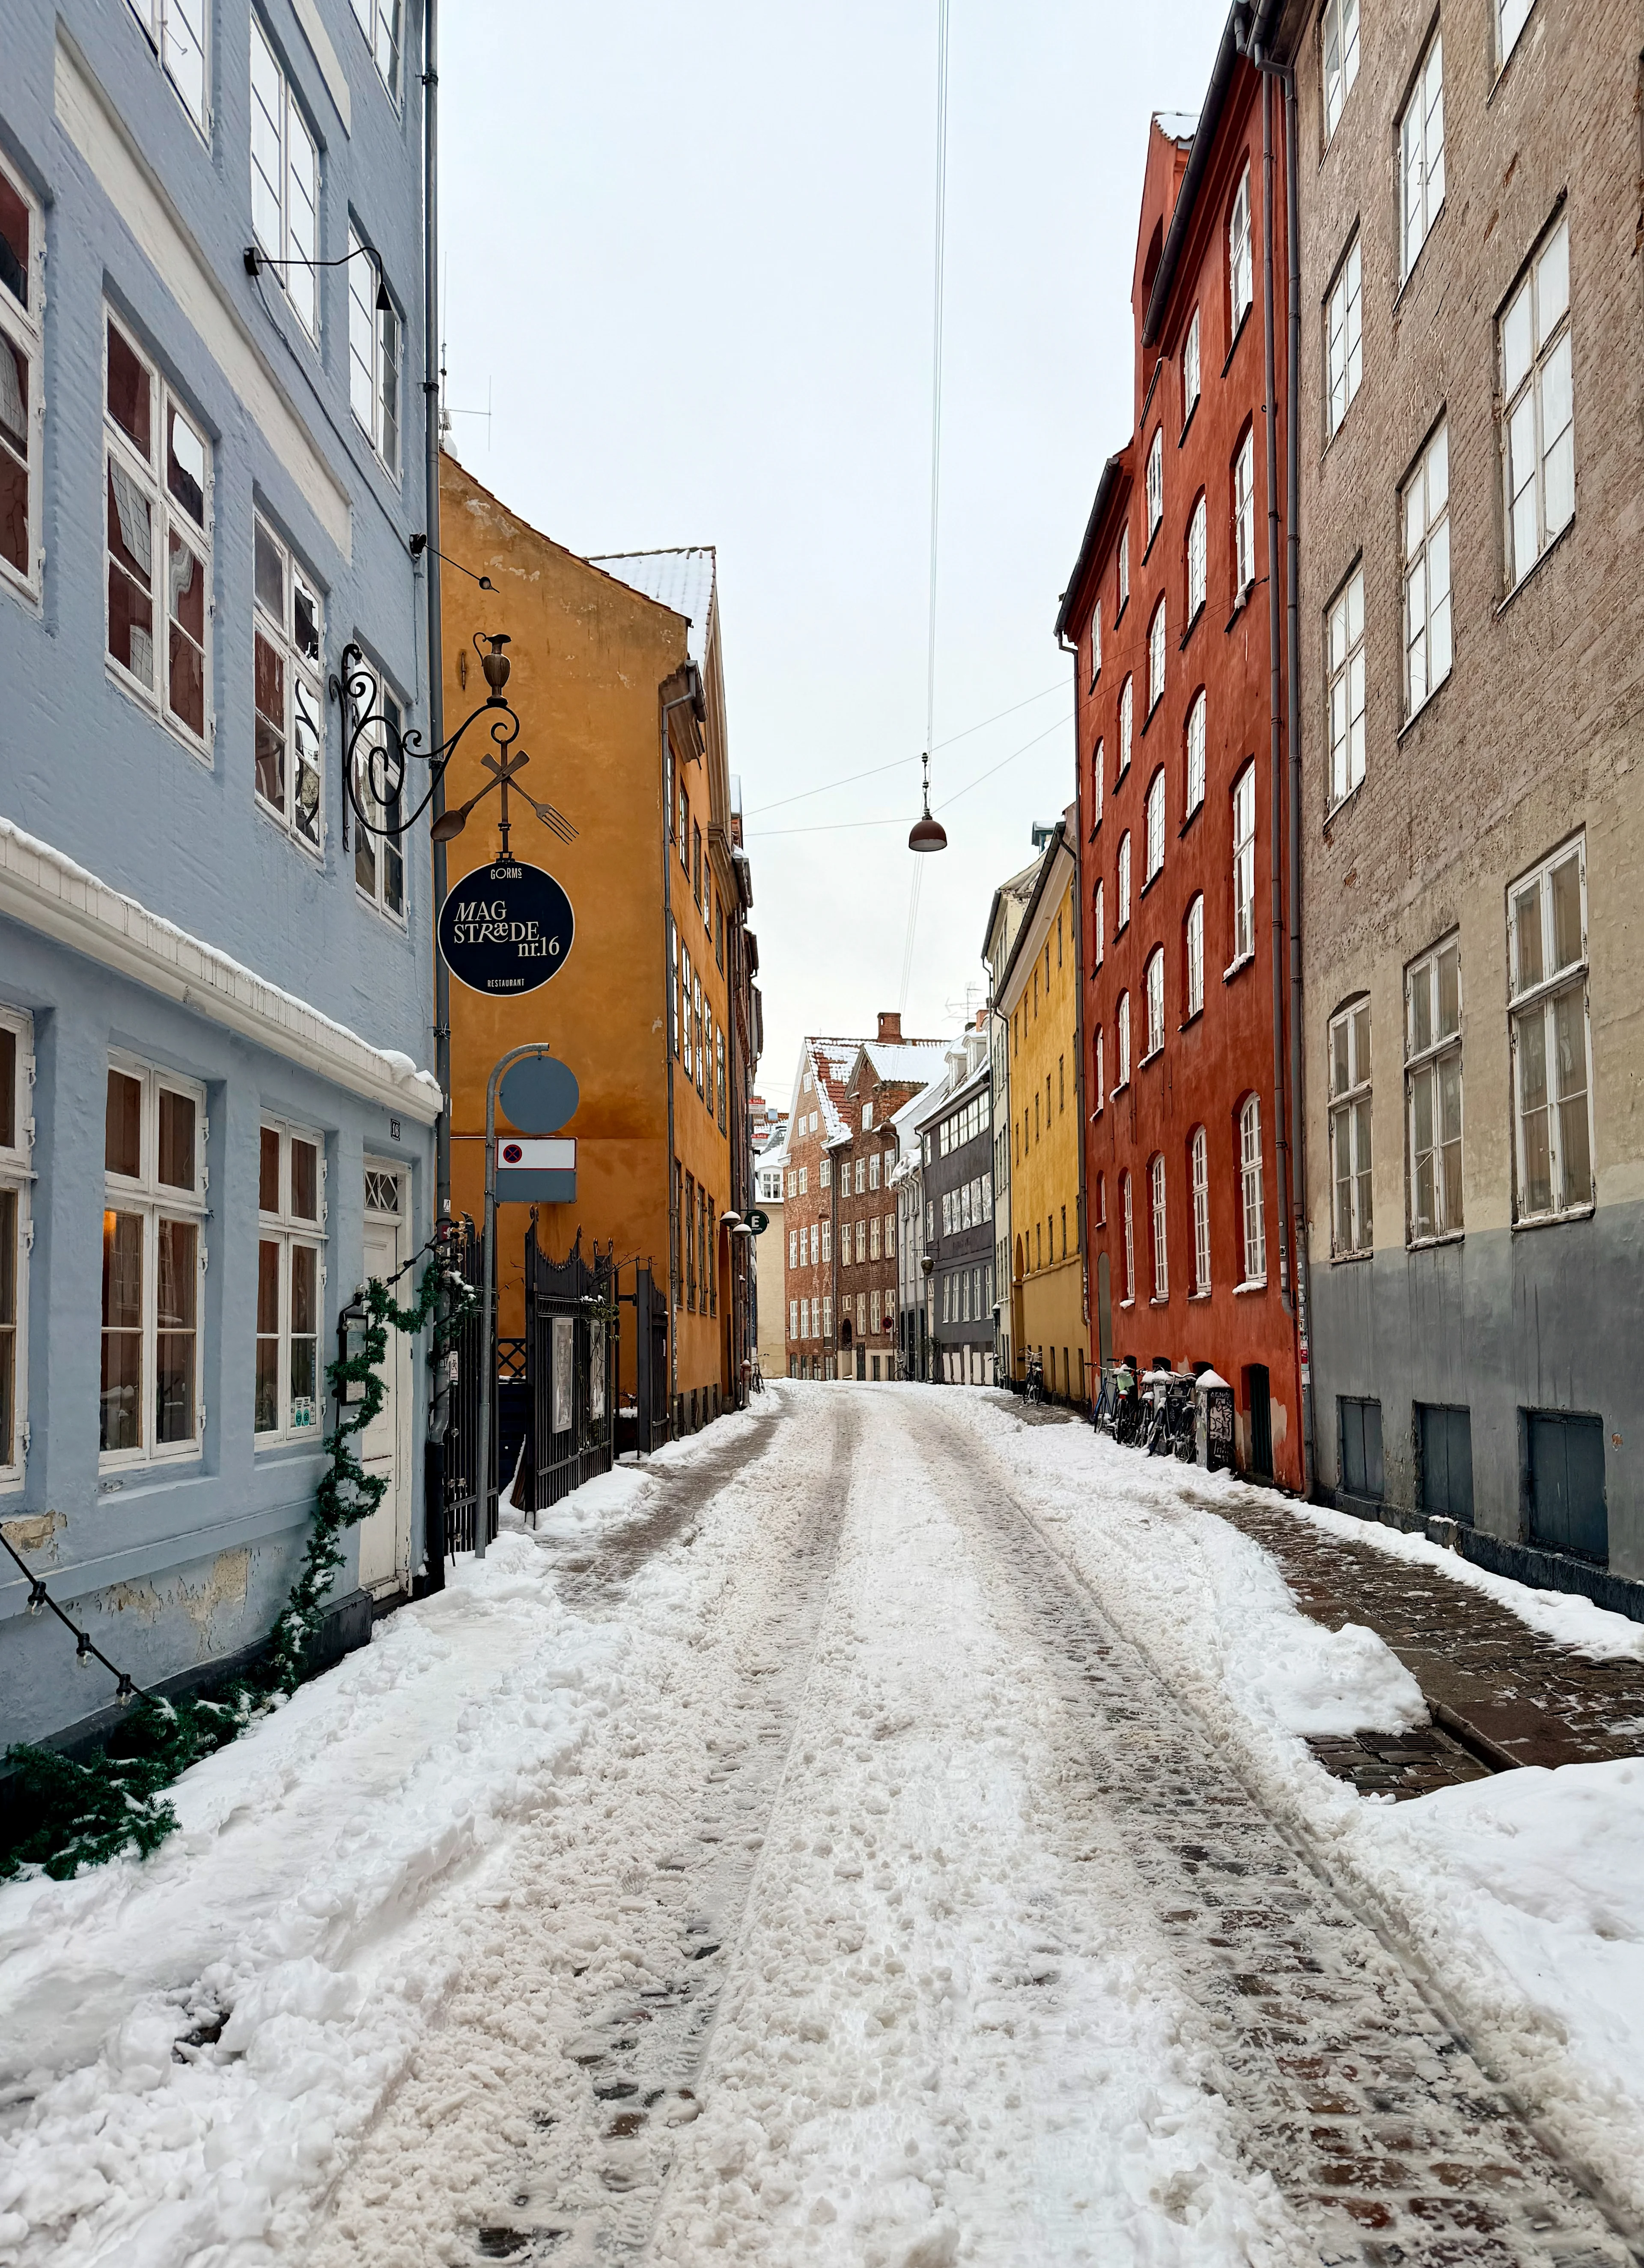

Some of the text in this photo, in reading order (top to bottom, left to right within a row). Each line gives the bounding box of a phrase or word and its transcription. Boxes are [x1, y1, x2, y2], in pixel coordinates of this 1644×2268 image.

[453, 900, 507, 921] MAG
[517, 936, 560, 957] nr.16
[487, 978, 525, 987] RESTAURANT
[751, 1216, 760, 1228] E
